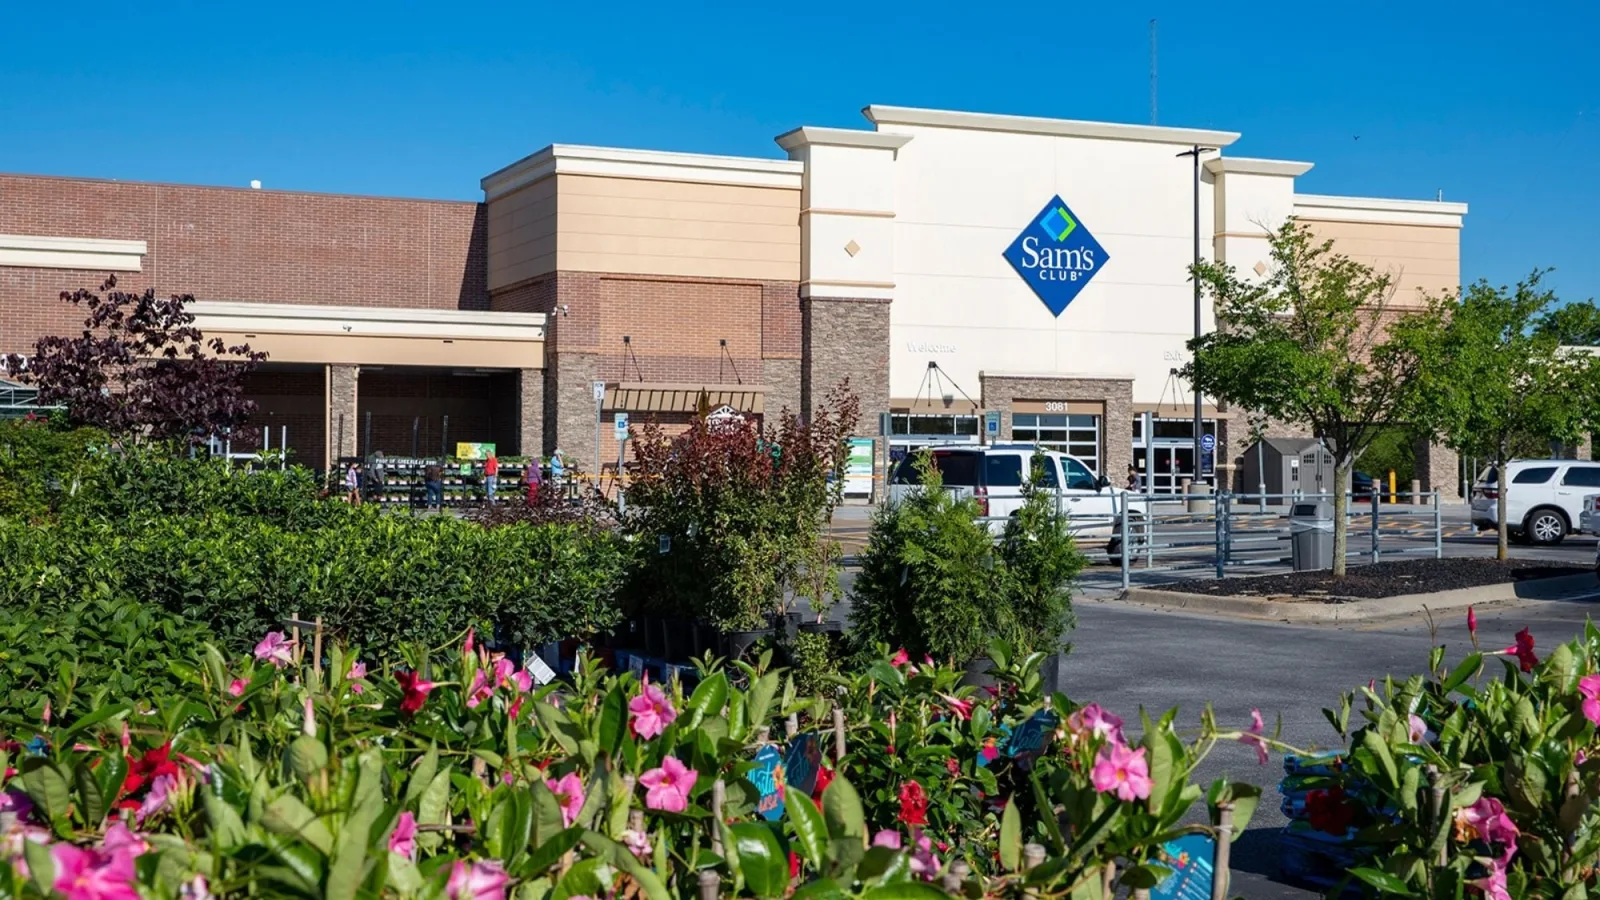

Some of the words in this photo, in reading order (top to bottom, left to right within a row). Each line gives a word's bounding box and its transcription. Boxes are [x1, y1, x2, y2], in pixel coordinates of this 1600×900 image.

[1021, 236, 1094, 271] Sam's
[1039, 269, 1078, 281] CLUB
[906, 340, 957, 353] Welcome
[1163, 350, 1183, 361] Exit
[1045, 402, 1069, 412] 3081
